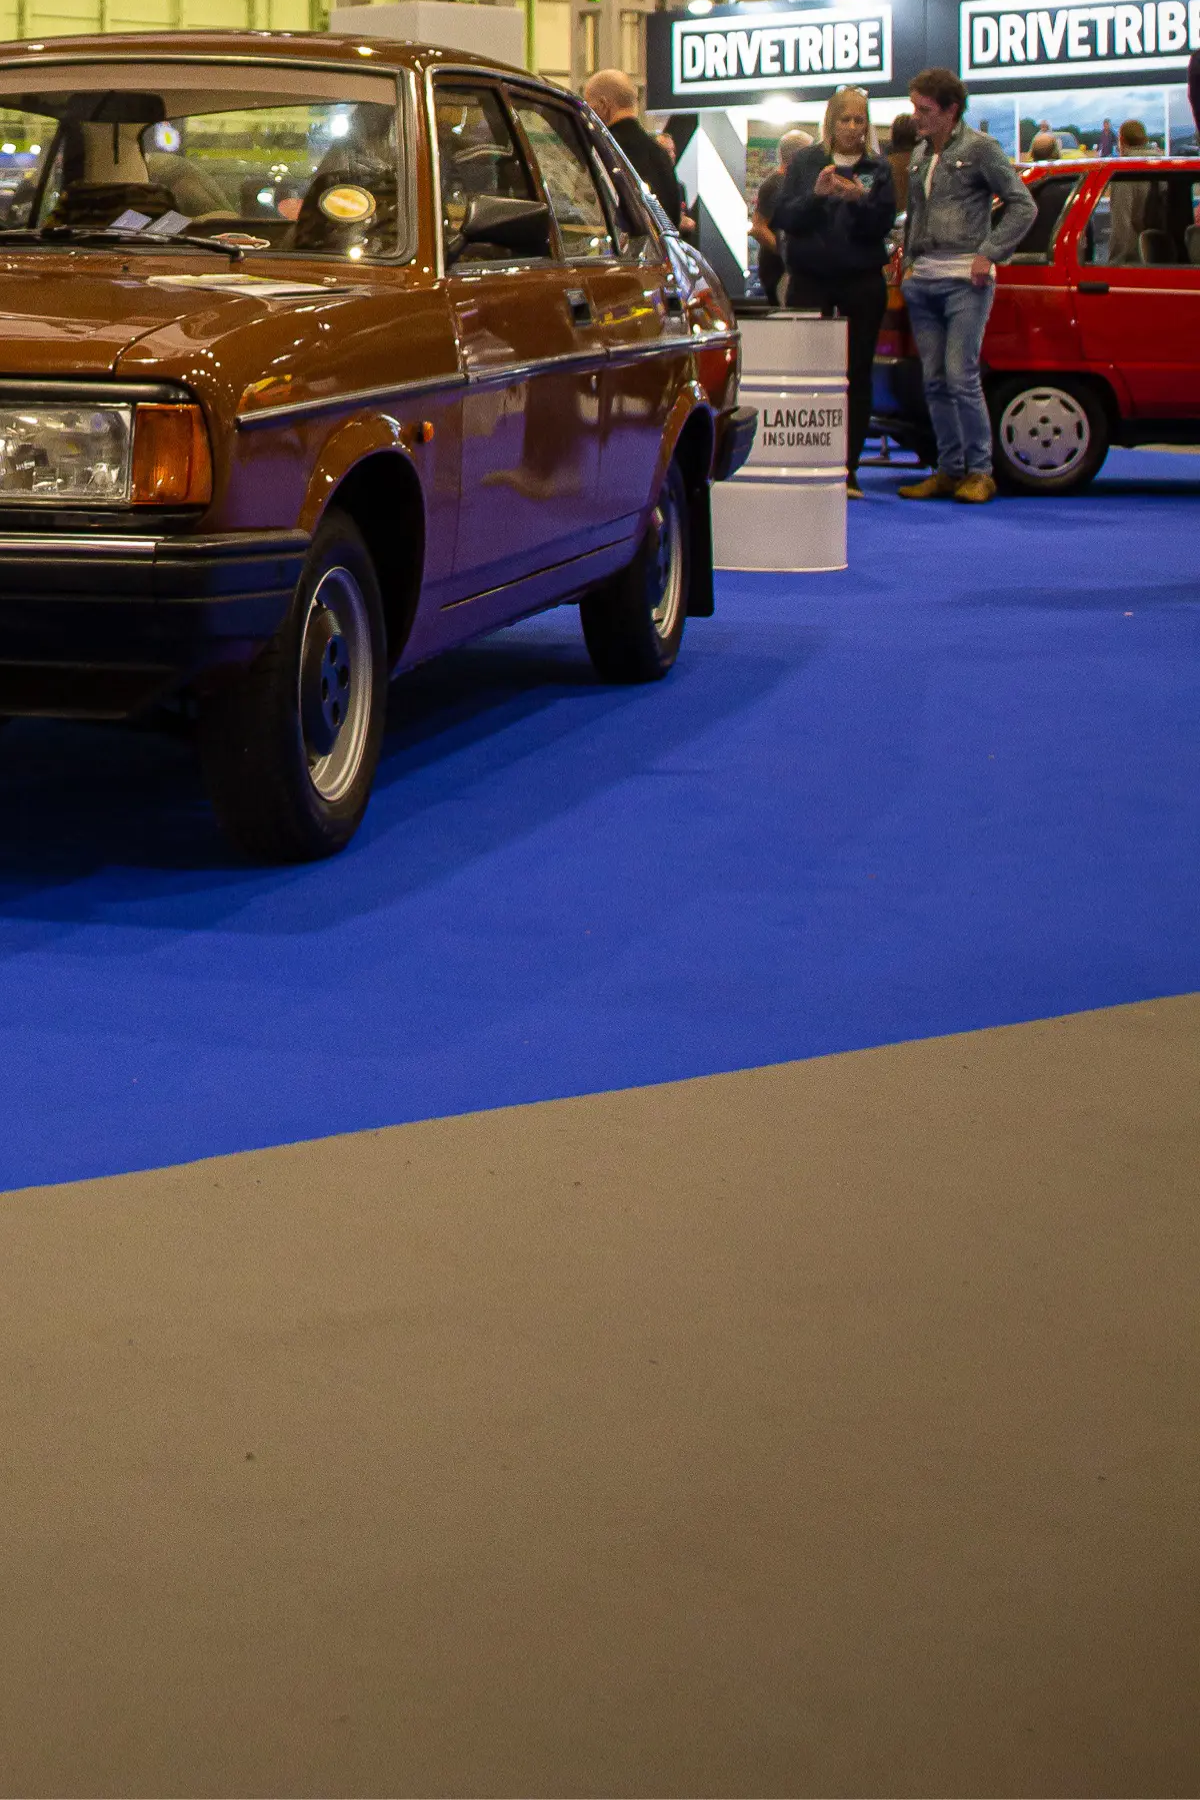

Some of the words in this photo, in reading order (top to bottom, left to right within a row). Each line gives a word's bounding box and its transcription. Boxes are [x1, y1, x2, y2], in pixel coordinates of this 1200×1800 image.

[683, 20, 881, 80] DRIVETRIBE
[763, 408, 844, 429] LANCASTER
[763, 431, 831, 448] INSURANCE
